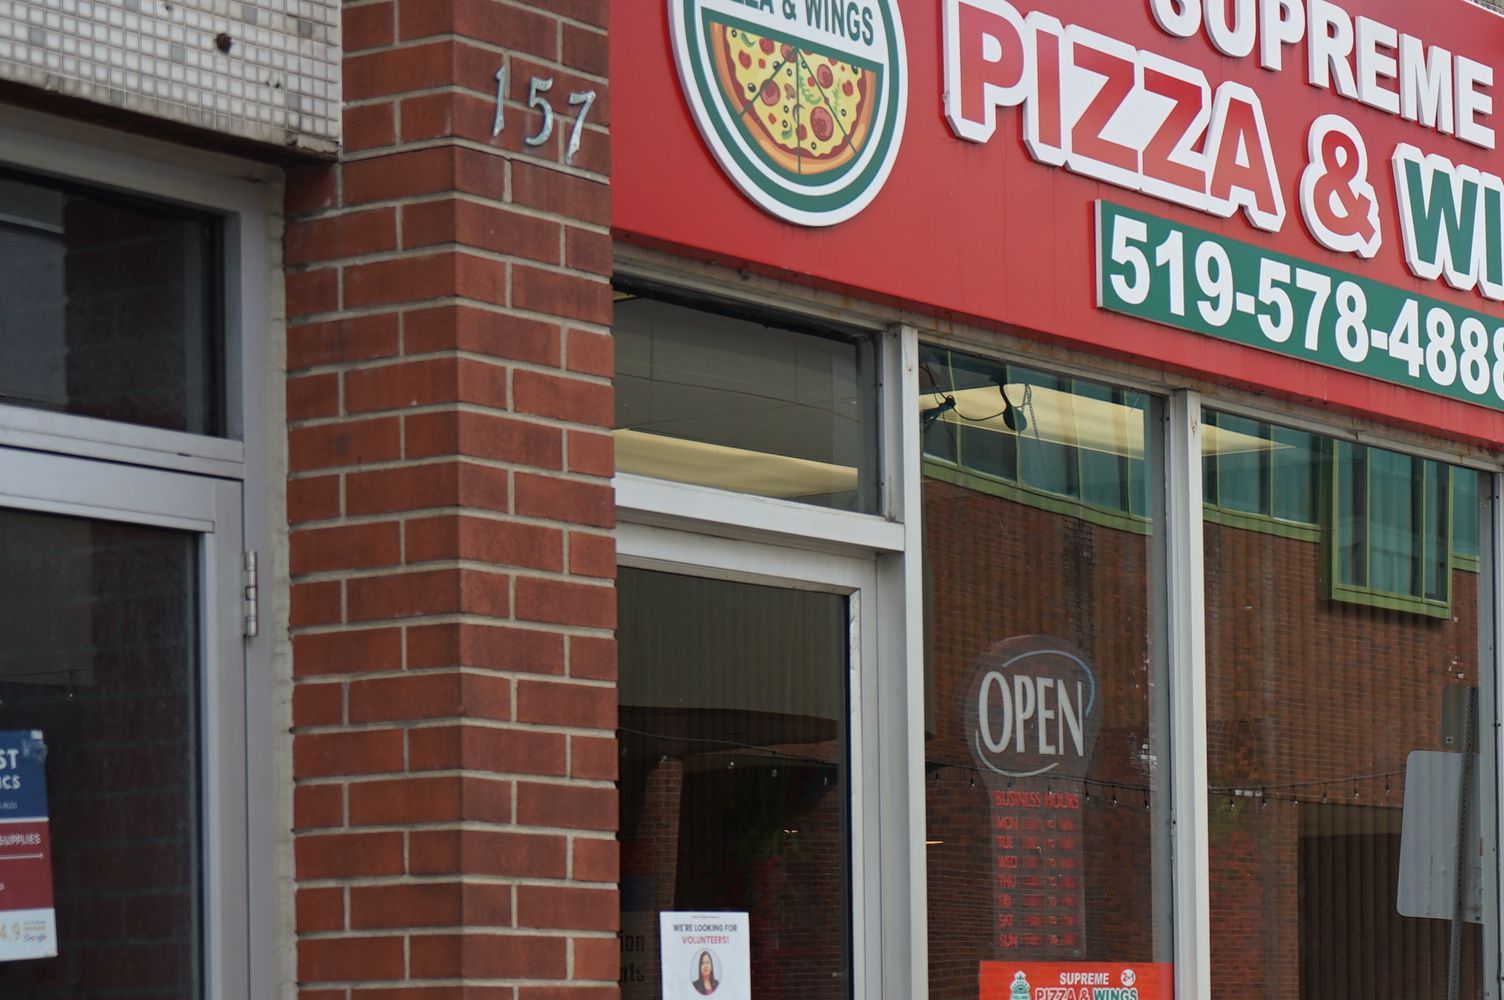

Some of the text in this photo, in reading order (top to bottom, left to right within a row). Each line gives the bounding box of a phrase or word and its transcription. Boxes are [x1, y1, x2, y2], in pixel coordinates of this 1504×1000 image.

[492, 65, 597, 165] 157
[945, 0, 1286, 232] PIZZA
[1299, 113, 1382, 258] &
[978, 670, 1084, 757] OPEN
[993, 790, 1080, 809] BUSINESS HOURS
[694, 924, 723, 932] LOOKING
[725, 924, 738, 932] FOR
[1059, 972, 1109, 985] SUPREME
